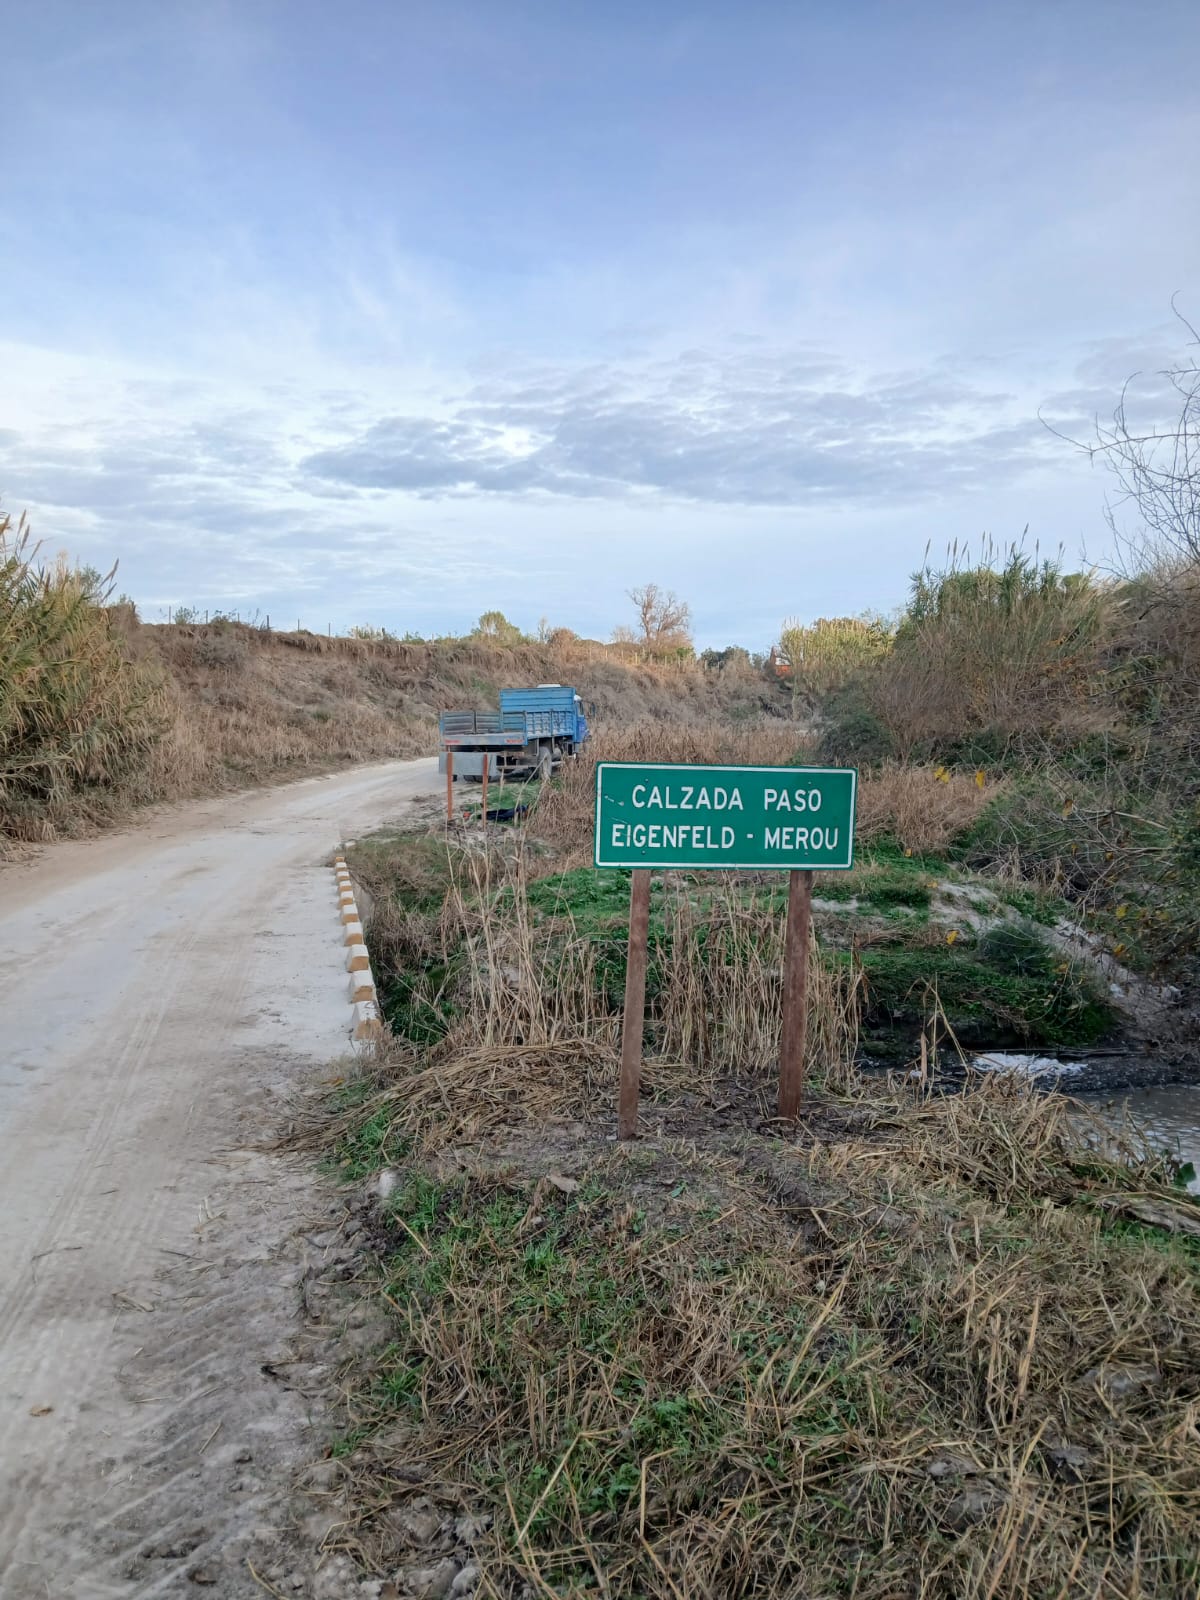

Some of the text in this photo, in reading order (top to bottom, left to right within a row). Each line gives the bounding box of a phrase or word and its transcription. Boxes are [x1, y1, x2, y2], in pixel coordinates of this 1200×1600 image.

[631, 784, 822, 812] CALZADA PASO
[611, 824, 736, 849] EIGENFELD
[764, 827, 839, 850] MEROU
